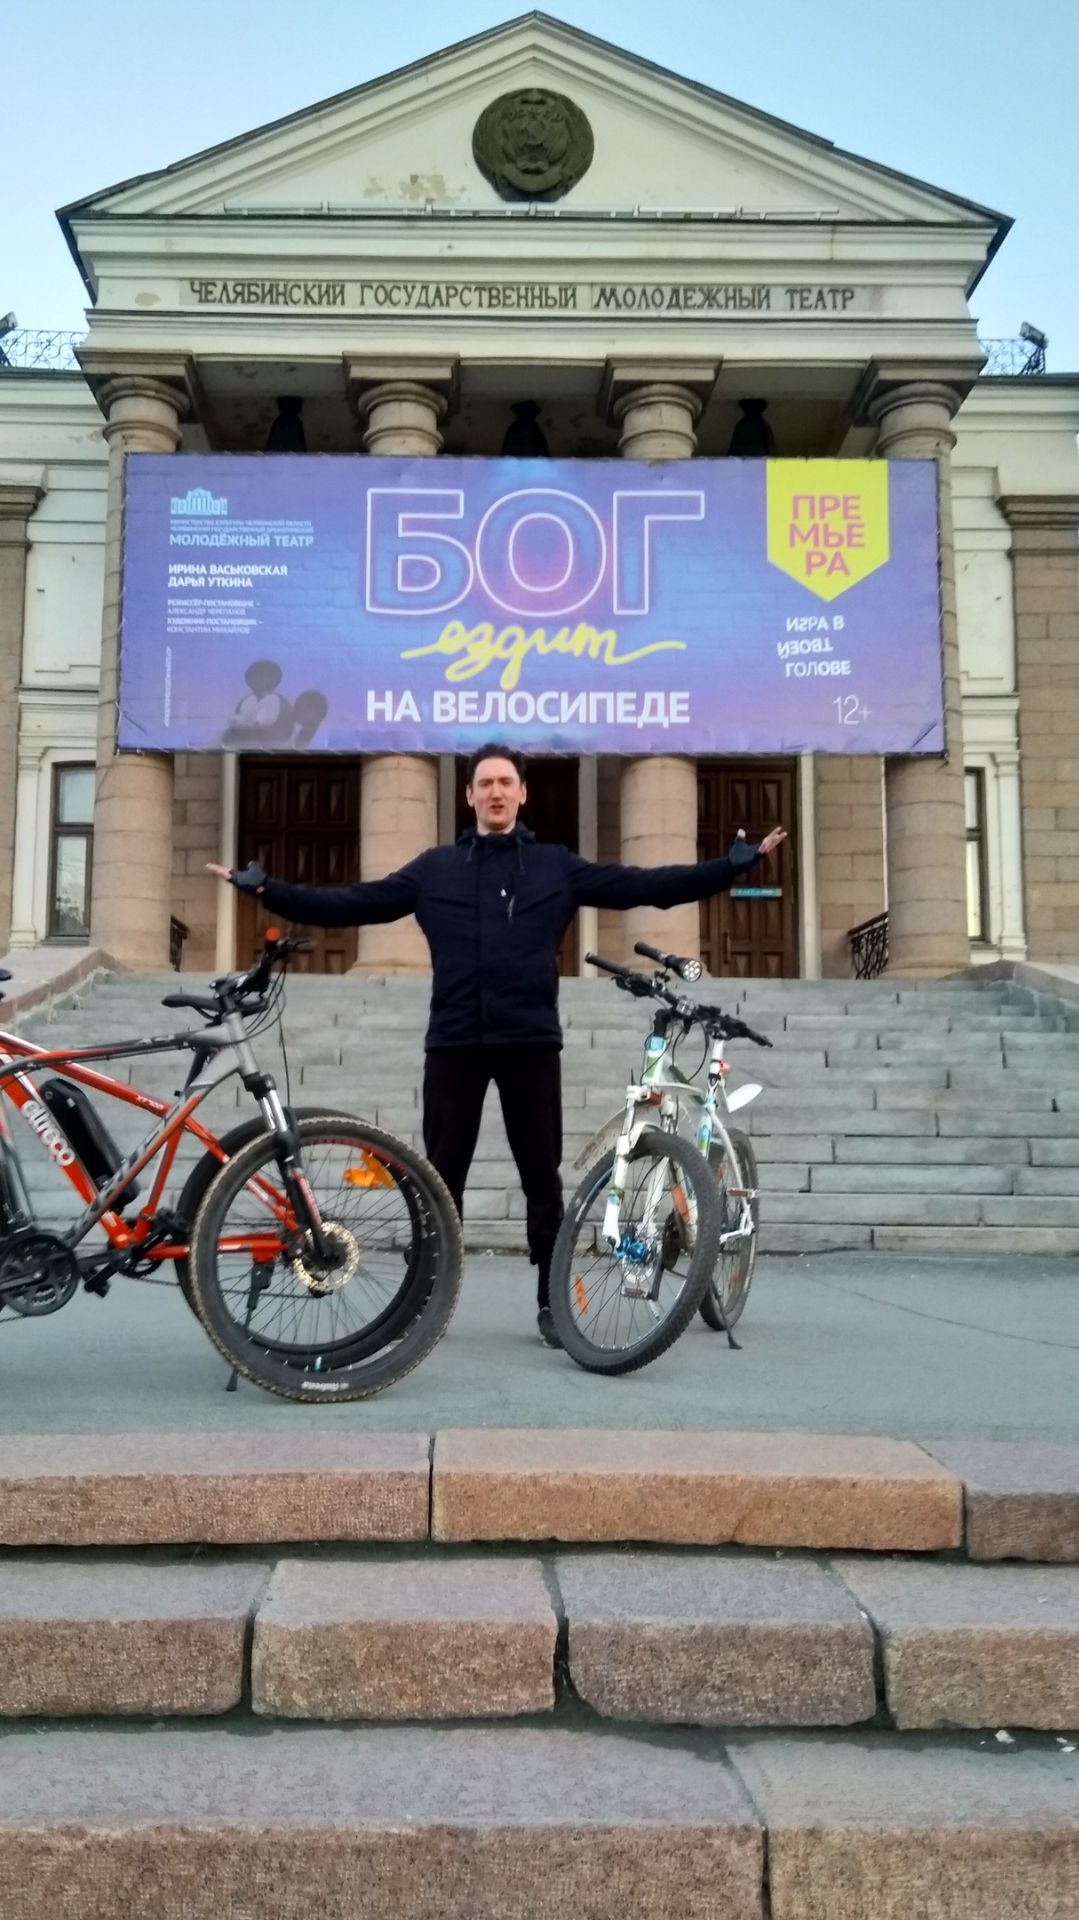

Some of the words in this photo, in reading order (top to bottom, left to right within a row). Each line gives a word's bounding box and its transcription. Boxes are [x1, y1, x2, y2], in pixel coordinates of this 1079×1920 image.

[190, 280, 346, 306] ЧЕЛЯБИНСКИЙ
[359, 282, 577, 309] ГОСУДАРСТВЕННЫЙ
[594, 284, 771, 311] МОЛОДЕЖНЫЙ
[785, 287, 855, 311] ТЕАТР
[791, 494, 862, 521] ПРЕ
[169, 532, 270, 547] МОЛОДЁЖНЫЙ
[273, 534, 314, 547] ТЕАТР
[788, 522, 866, 548] МЬЕ
[365, 487, 706, 618] БОГ
[803, 550, 851, 577] РА
[167, 576, 205, 588] ДАРЬЯ
[207, 577, 253, 588] УТКИНА
[168, 563, 207, 575] ИРИНА
[209, 564, 288, 576] ВАСЬКОВСКАЯ
[832, 615, 845, 630] В
[400, 620, 687, 690] ездит
[777, 637, 834, 659] ТВОЕЙ
[785, 660, 852, 678] ГОЛОВЕ
[366, 690, 422, 723] НА
[432, 690, 690, 728] ВЕЛОСИПЕДЕ
[832, 694, 872, 725] 12+
